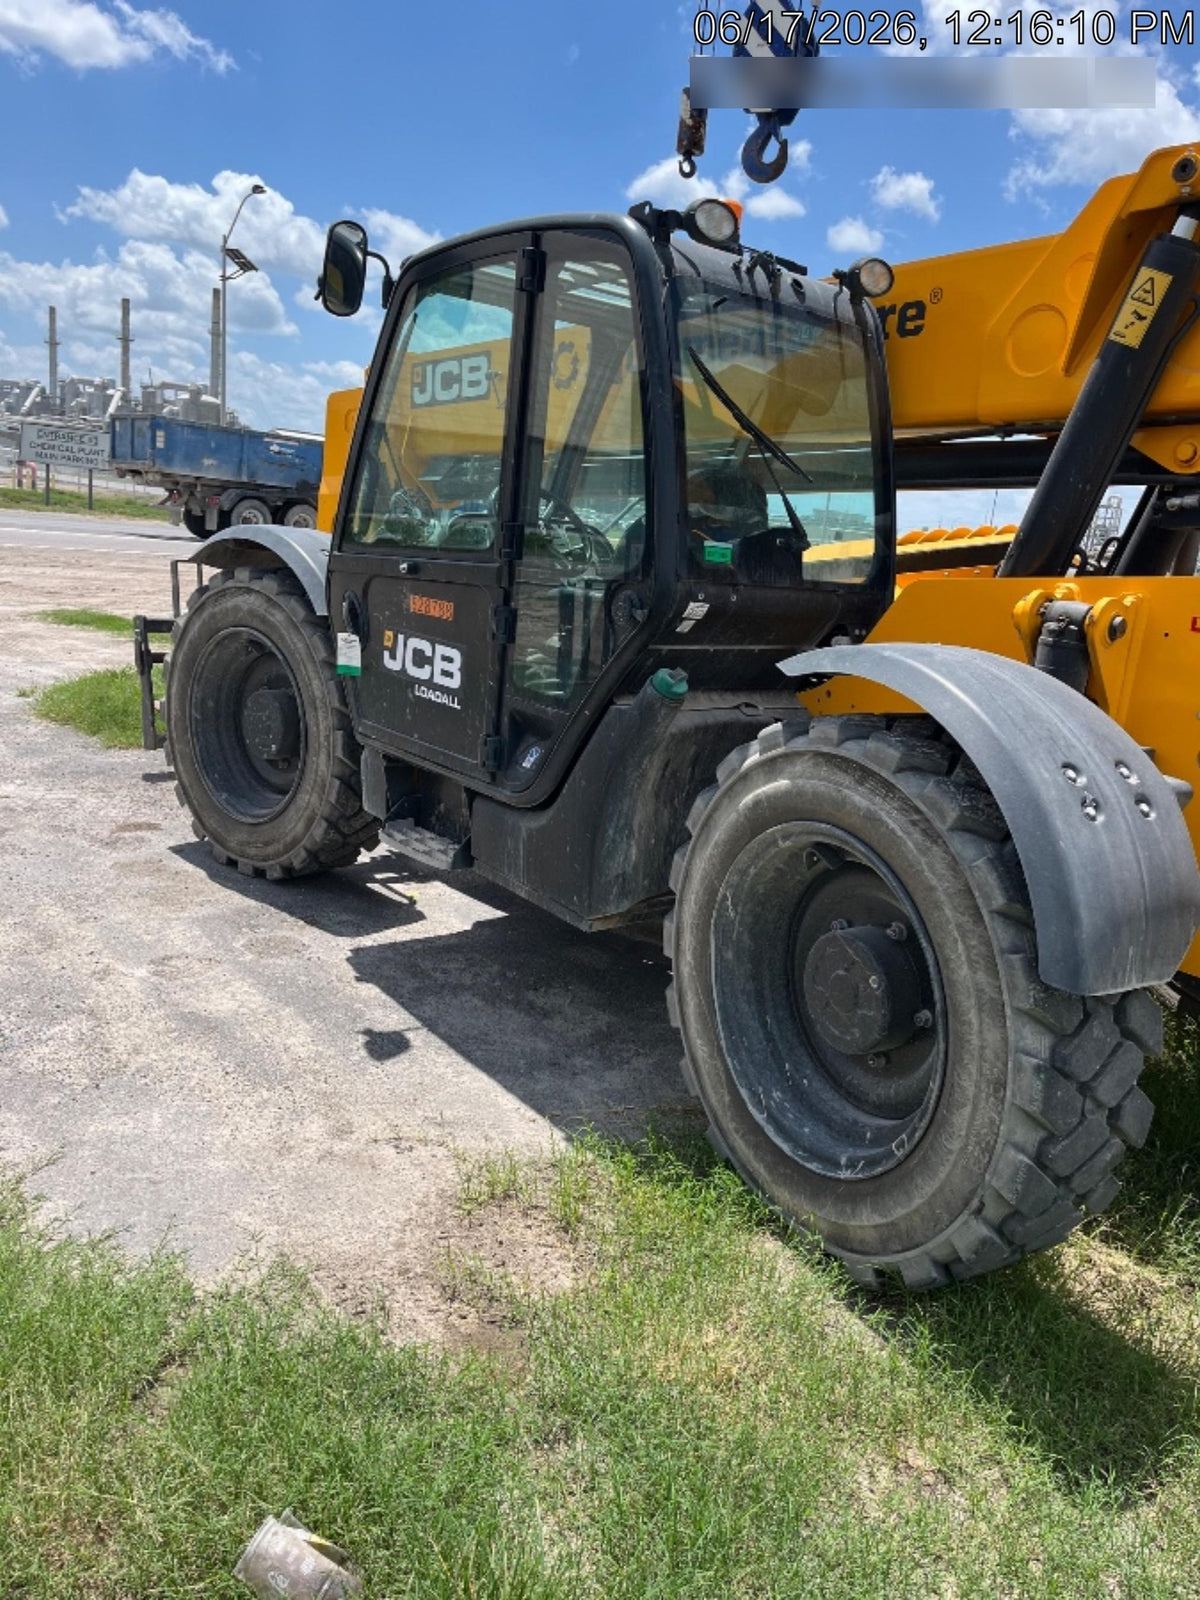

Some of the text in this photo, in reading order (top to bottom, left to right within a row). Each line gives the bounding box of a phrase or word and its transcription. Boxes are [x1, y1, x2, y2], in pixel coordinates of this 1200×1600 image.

[413, 356, 488, 404] JCB
[37, 429, 86, 445] ENTRANCE
[29, 441, 105, 457] CHEMICAL PLANT
[35, 451, 98, 465] MAIN PARKING
[383, 630, 462, 689] JCB
[415, 683, 461, 710] LOADALL
